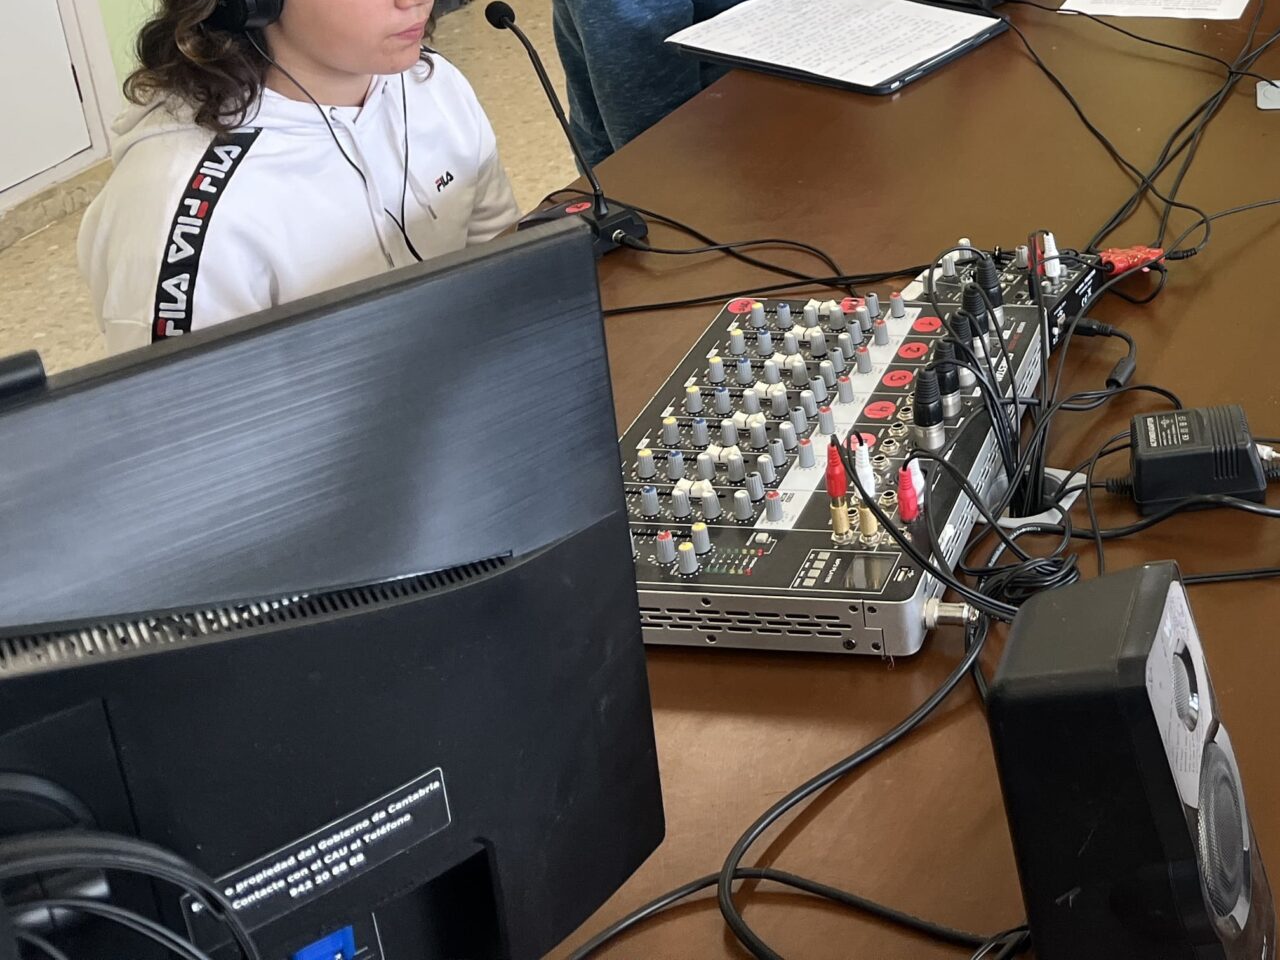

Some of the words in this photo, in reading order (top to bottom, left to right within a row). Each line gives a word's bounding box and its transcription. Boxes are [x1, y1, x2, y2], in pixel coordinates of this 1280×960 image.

[192, 144, 242, 194] FILA
[435, 171, 454, 192] FILA
[167, 198, 209, 264] FILA
[156, 273, 190, 337] FILA
[232, 879, 285, 910] Contacte
[287, 867, 309, 883] con
[310, 858, 323, 872] el
[323, 845, 349, 864] CAU
[362, 813, 411, 843] Teléfono
[235, 855, 296, 893] propiedad
[297, 846, 316, 861] del
[318, 819, 370, 850] Gobierno
[371, 809, 386, 823] de
[388, 780, 440, 814] Cantabria
[314, 871, 331, 884] 20
